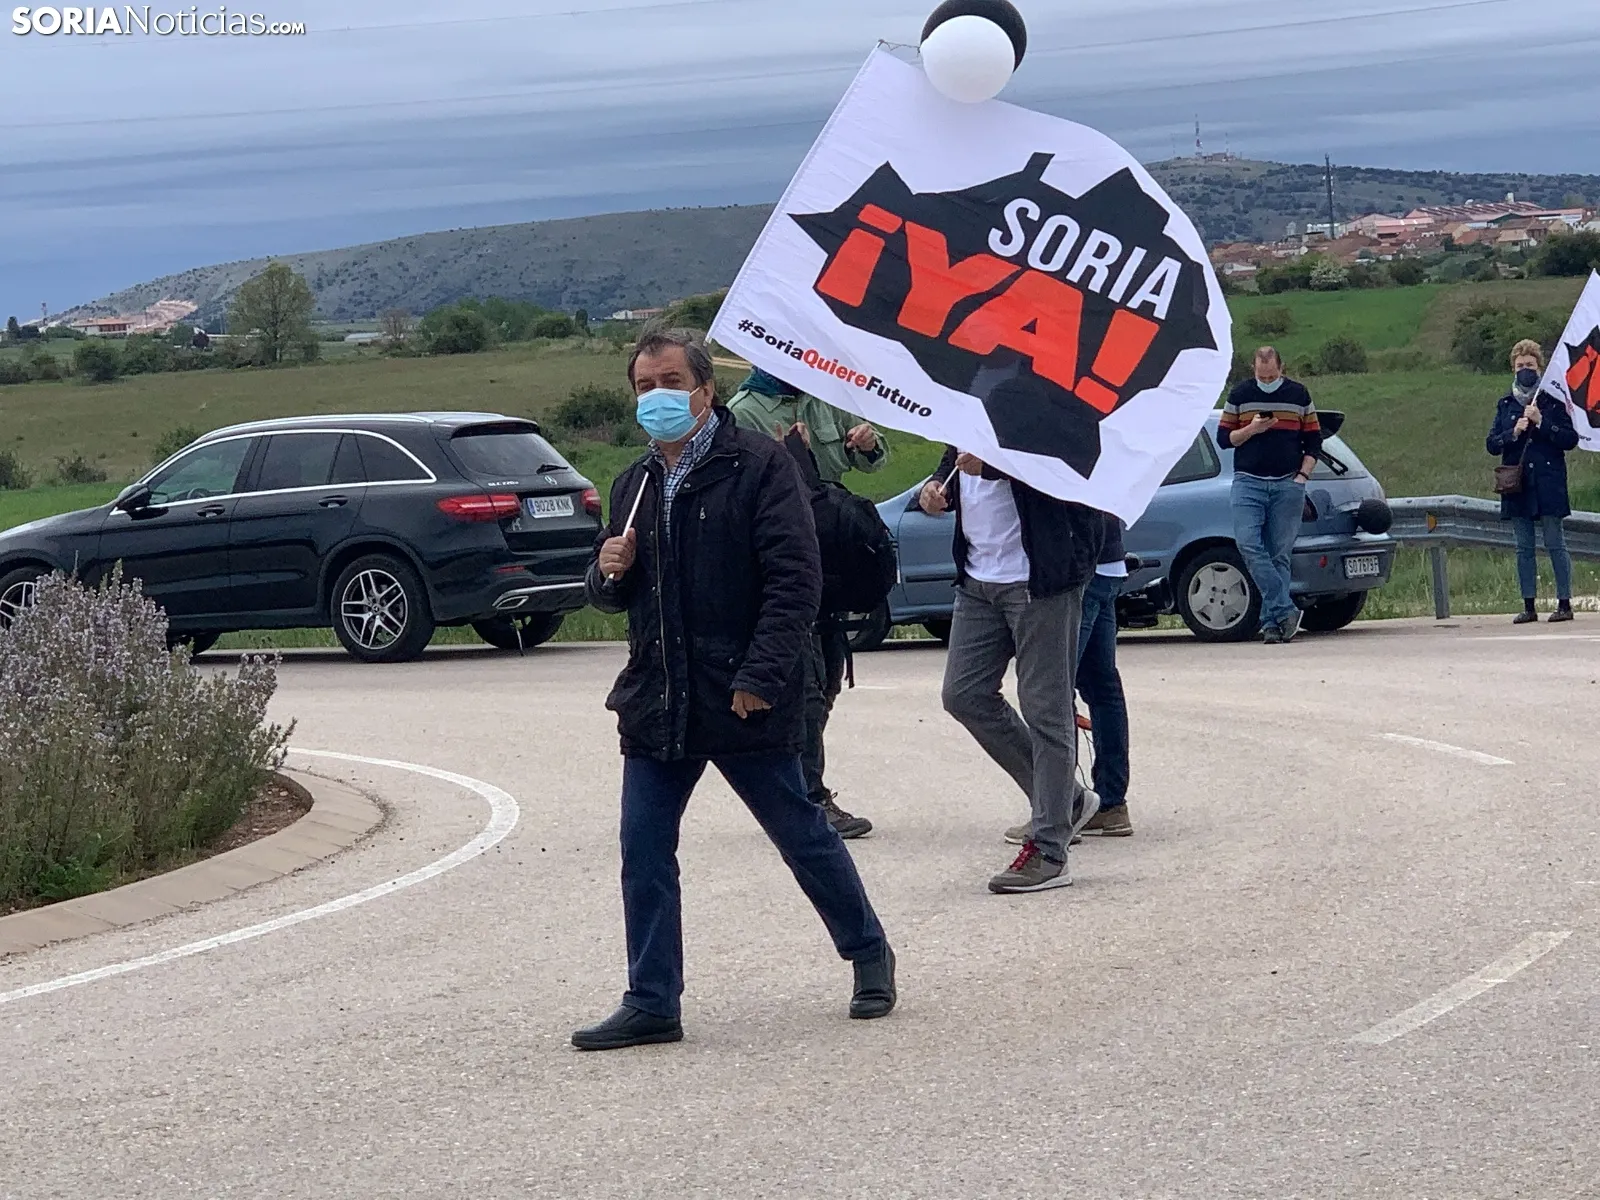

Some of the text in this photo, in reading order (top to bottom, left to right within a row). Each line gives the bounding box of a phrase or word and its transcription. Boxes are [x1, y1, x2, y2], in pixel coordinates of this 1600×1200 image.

[816, 203, 1160, 414] ¡YA!
[988, 198, 1182, 320] SORIA
[737, 318, 932, 419] #SoriaQuiereFuturo
[535, 498, 572, 512] 9028 KNK
